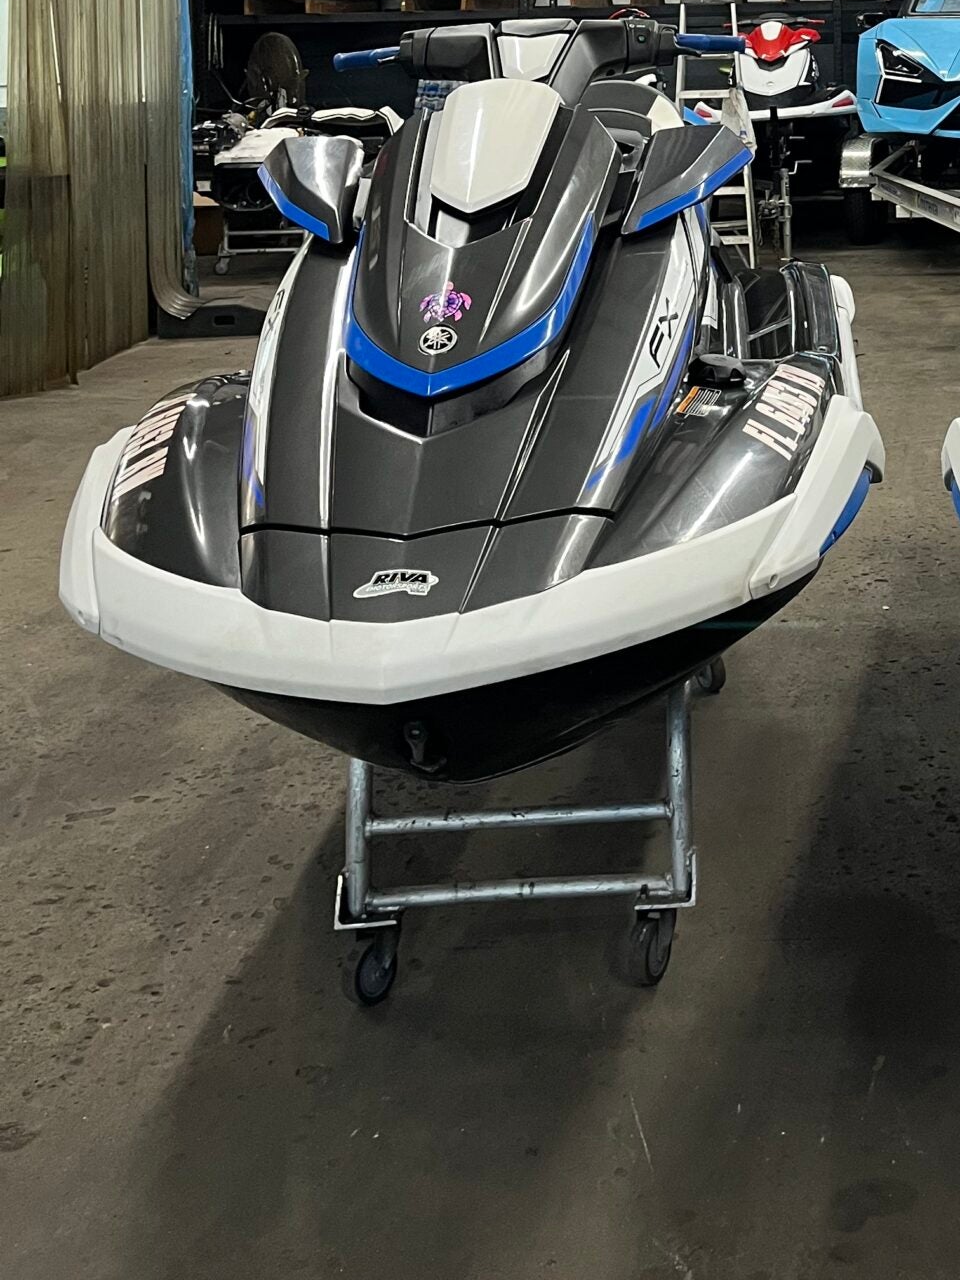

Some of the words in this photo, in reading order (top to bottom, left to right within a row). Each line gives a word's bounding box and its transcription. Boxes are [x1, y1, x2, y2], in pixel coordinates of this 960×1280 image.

[649, 297, 679, 370] FX
[742, 418, 799, 461] FL
[112, 446, 169, 500] RW
[373, 572, 428, 585] RIVA
